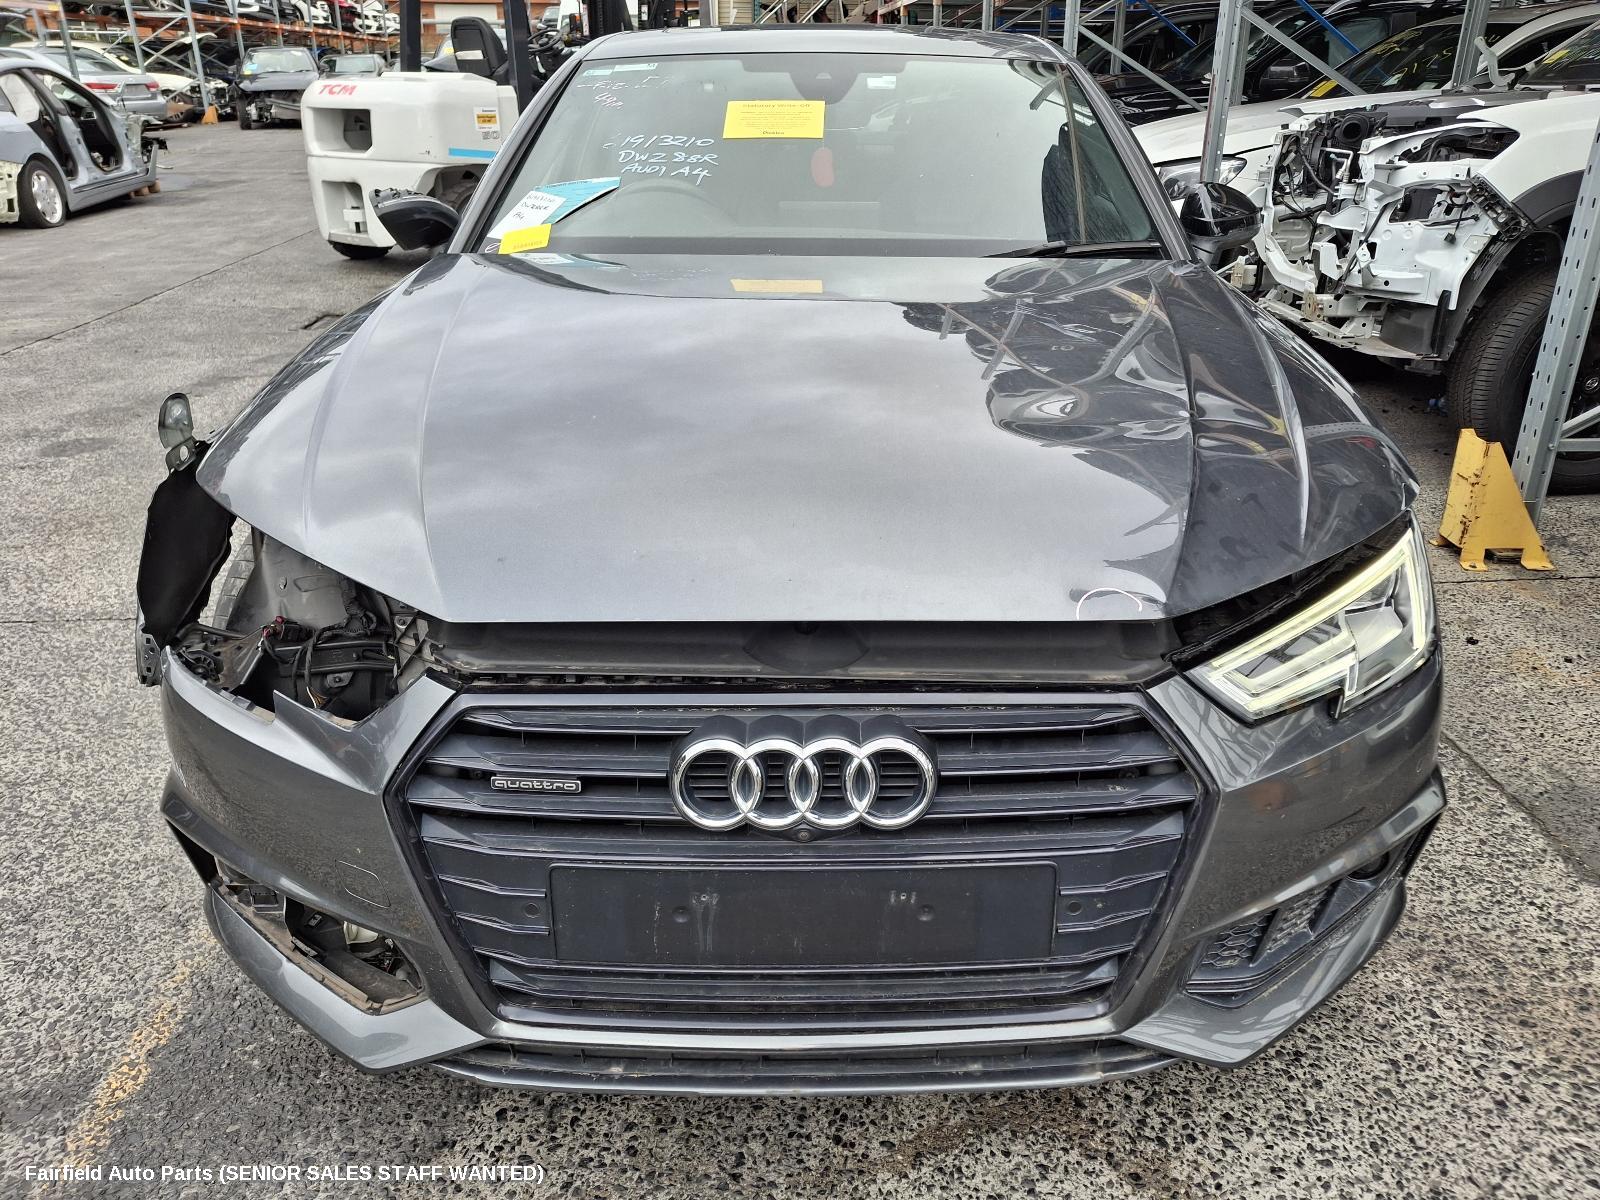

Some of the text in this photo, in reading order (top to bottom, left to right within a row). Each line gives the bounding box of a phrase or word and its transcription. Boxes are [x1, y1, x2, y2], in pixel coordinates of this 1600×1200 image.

[319, 84, 357, 96] TCM
[670, 165, 712, 186] A4
[494, 780, 577, 790] quattro
